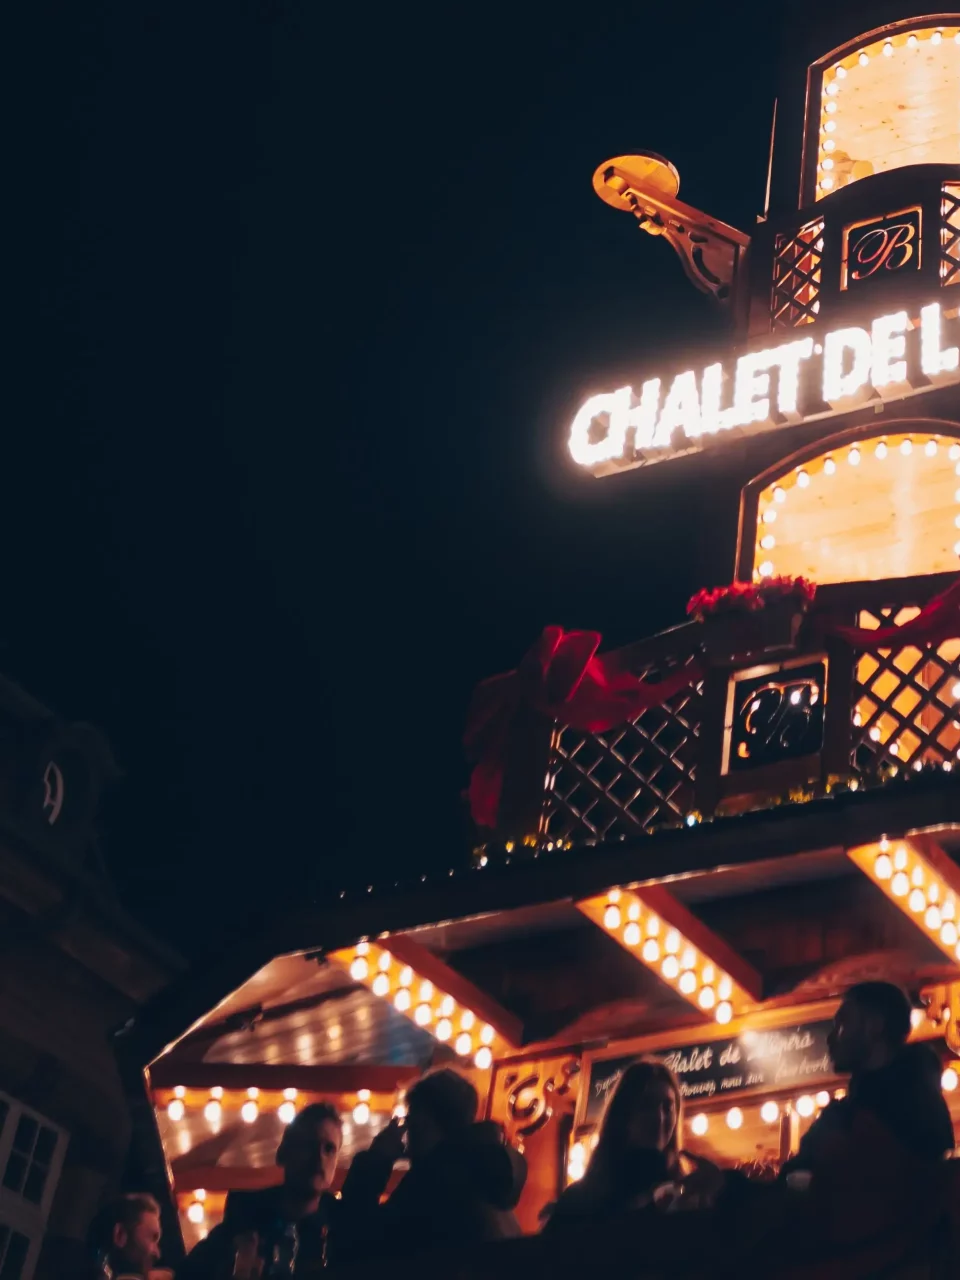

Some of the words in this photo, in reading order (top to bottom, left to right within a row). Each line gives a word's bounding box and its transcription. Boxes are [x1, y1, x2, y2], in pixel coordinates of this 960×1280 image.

[851, 221, 916, 281] B
[568, 337, 814, 466] CHALET
[822, 311, 908, 402] DE
[719, 1043, 742, 1067] de
